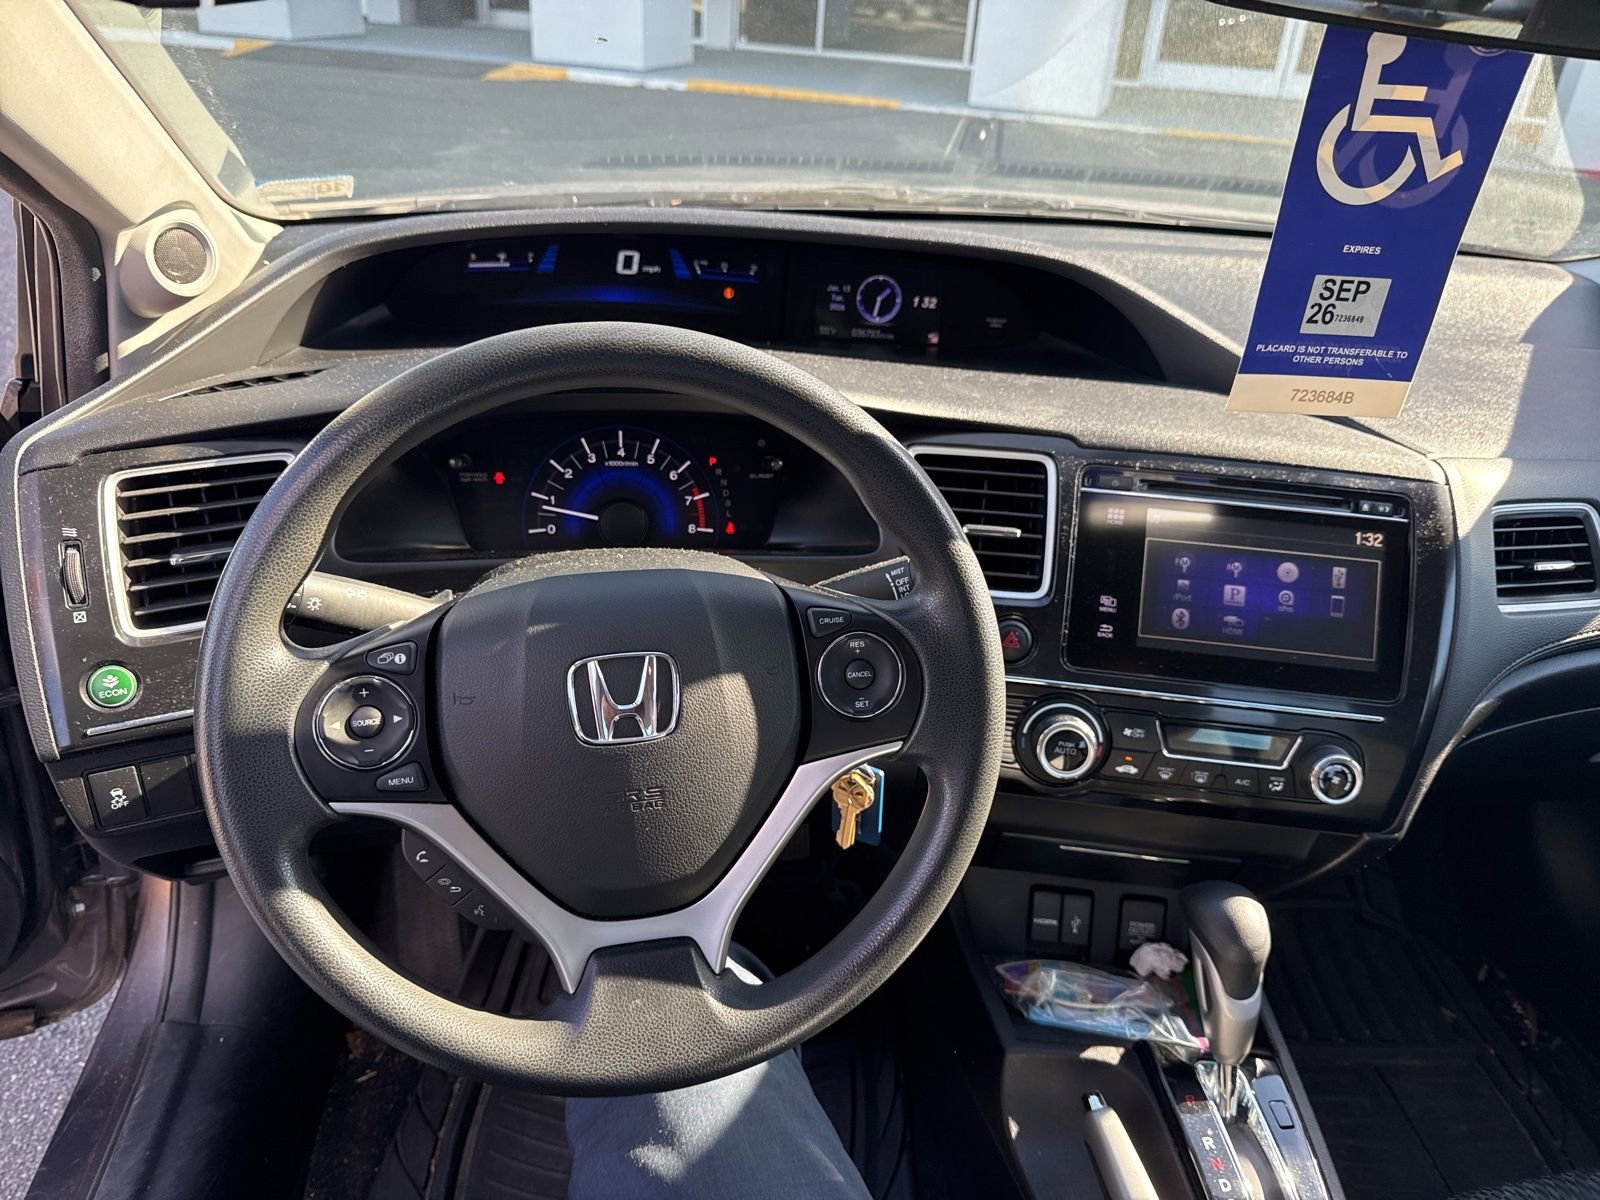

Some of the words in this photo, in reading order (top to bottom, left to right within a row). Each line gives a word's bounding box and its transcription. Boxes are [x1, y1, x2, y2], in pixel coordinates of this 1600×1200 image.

[1343, 245, 1381, 254] EXPIRES
[616, 249, 640, 275] 0
[1319, 278, 1371, 302] SEP
[1306, 303, 1336, 325] 26
[1335, 314, 1365, 323] 723684B
[1256, 344, 1296, 353] PLACARD
[1297, 345, 1306, 353] IS
[1307, 346, 1326, 355] NOT
[1327, 347, 1394, 358] TRANSFERABLE
[1396, 351, 1408, 359] TO
[1292, 355, 1322, 364] OTHER
[1323, 357, 1364, 366] PERSONS
[1290, 389, 1355, 404] 723684B
[617, 447, 626, 458] 4
[588, 453, 597, 464] 3
[647, 454, 656, 465] 5
[564, 468, 574, 479] 2
[670, 471, 678, 481] 6
[550, 495, 556, 505] 1
[685, 496, 693, 506] 7
[547, 523, 556, 535] 0
[688, 522, 697, 534] 8
[1354, 531, 1384, 548] 1:32
[890, 566, 905, 576] MIST
[895, 576, 909, 586] OFF
[898, 583, 910, 593] INT
[818, 616, 845, 625] CRUISE
[849, 640, 865, 648] RES
[847, 671, 872, 679] CANCEL
[98, 687, 128, 699] ECON
[854, 700, 870, 708] SET
[352, 717, 381, 727] SOURCE
[1057, 740, 1076, 748] PUSH
[1053, 747, 1077, 757] AUTO
[388, 776, 415, 786] MENU
[1234, 778, 1251, 786] A/C
[110, 800, 129, 810] OFF
[1202, 1136, 1215, 1150] R
[1210, 1157, 1224, 1169] N
[1218, 1178, 1231, 1192] D
